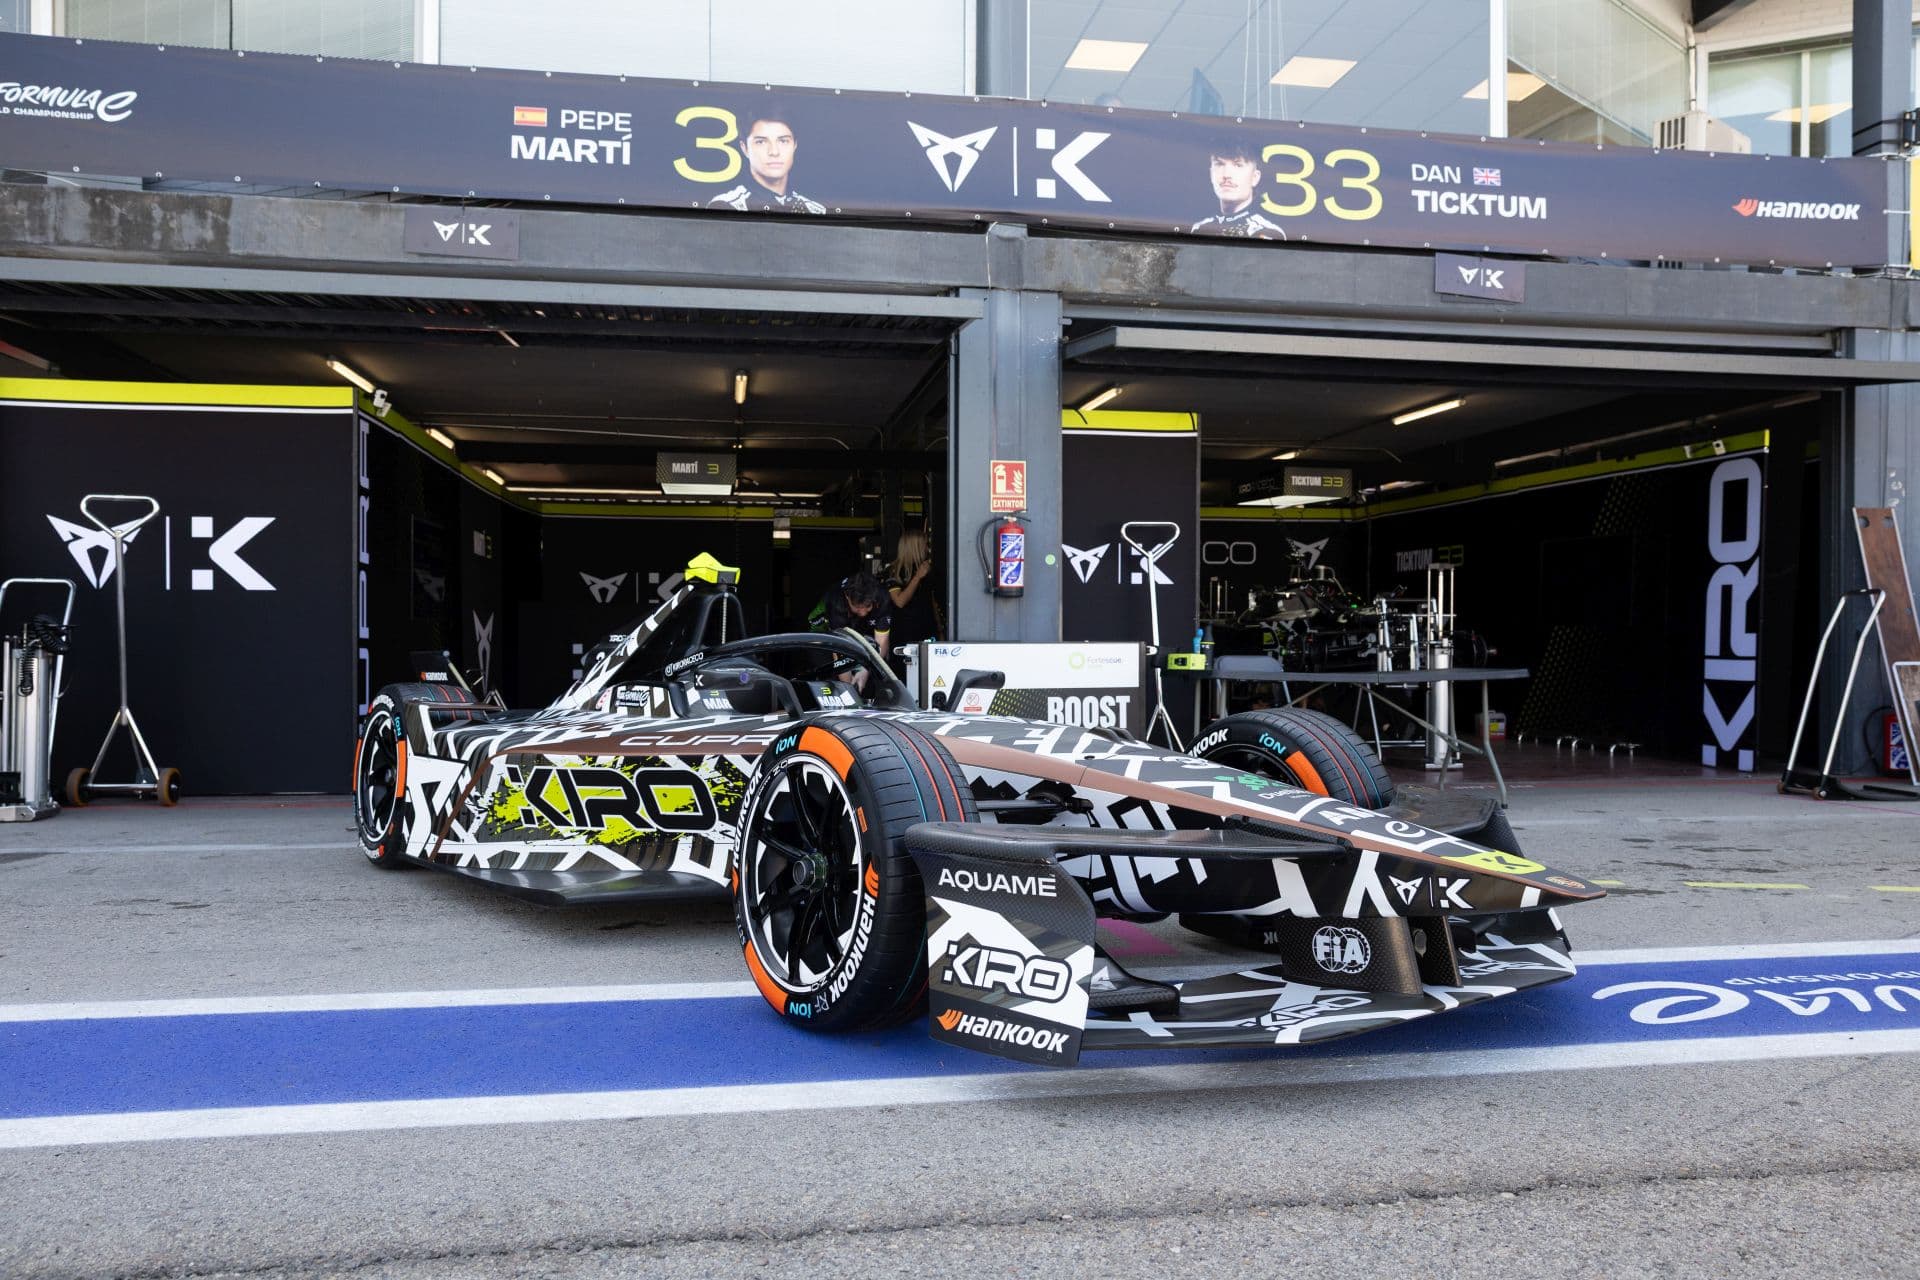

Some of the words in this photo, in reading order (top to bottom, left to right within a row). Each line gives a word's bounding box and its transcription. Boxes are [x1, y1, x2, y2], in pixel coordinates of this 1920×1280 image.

[13, 108, 94, 119] CHAMPIONSHIP
[560, 109, 632, 133] PEPE
[511, 134, 632, 165] MARTÍ
[673, 106, 742, 183] 3
[1260, 144, 1383, 221] 33
[1411, 163, 1461, 184] DAN
[1411, 189, 1547, 219] TICKTUM
[671, 460, 698, 474] MARTÍ
[706, 463, 719, 474] 3
[1291, 475, 1321, 486] TICKTUM
[1322, 476, 1344, 487] 33
[993, 499, 1025, 509] EXTINTOR
[1396, 548, 1433, 573] TICKTUM
[1702, 457, 1762, 772] KIRO
[1047, 695, 1131, 729] BOOST
[504, 765, 719, 833] KIRO
[943, 943, 1069, 1001] KIRO
